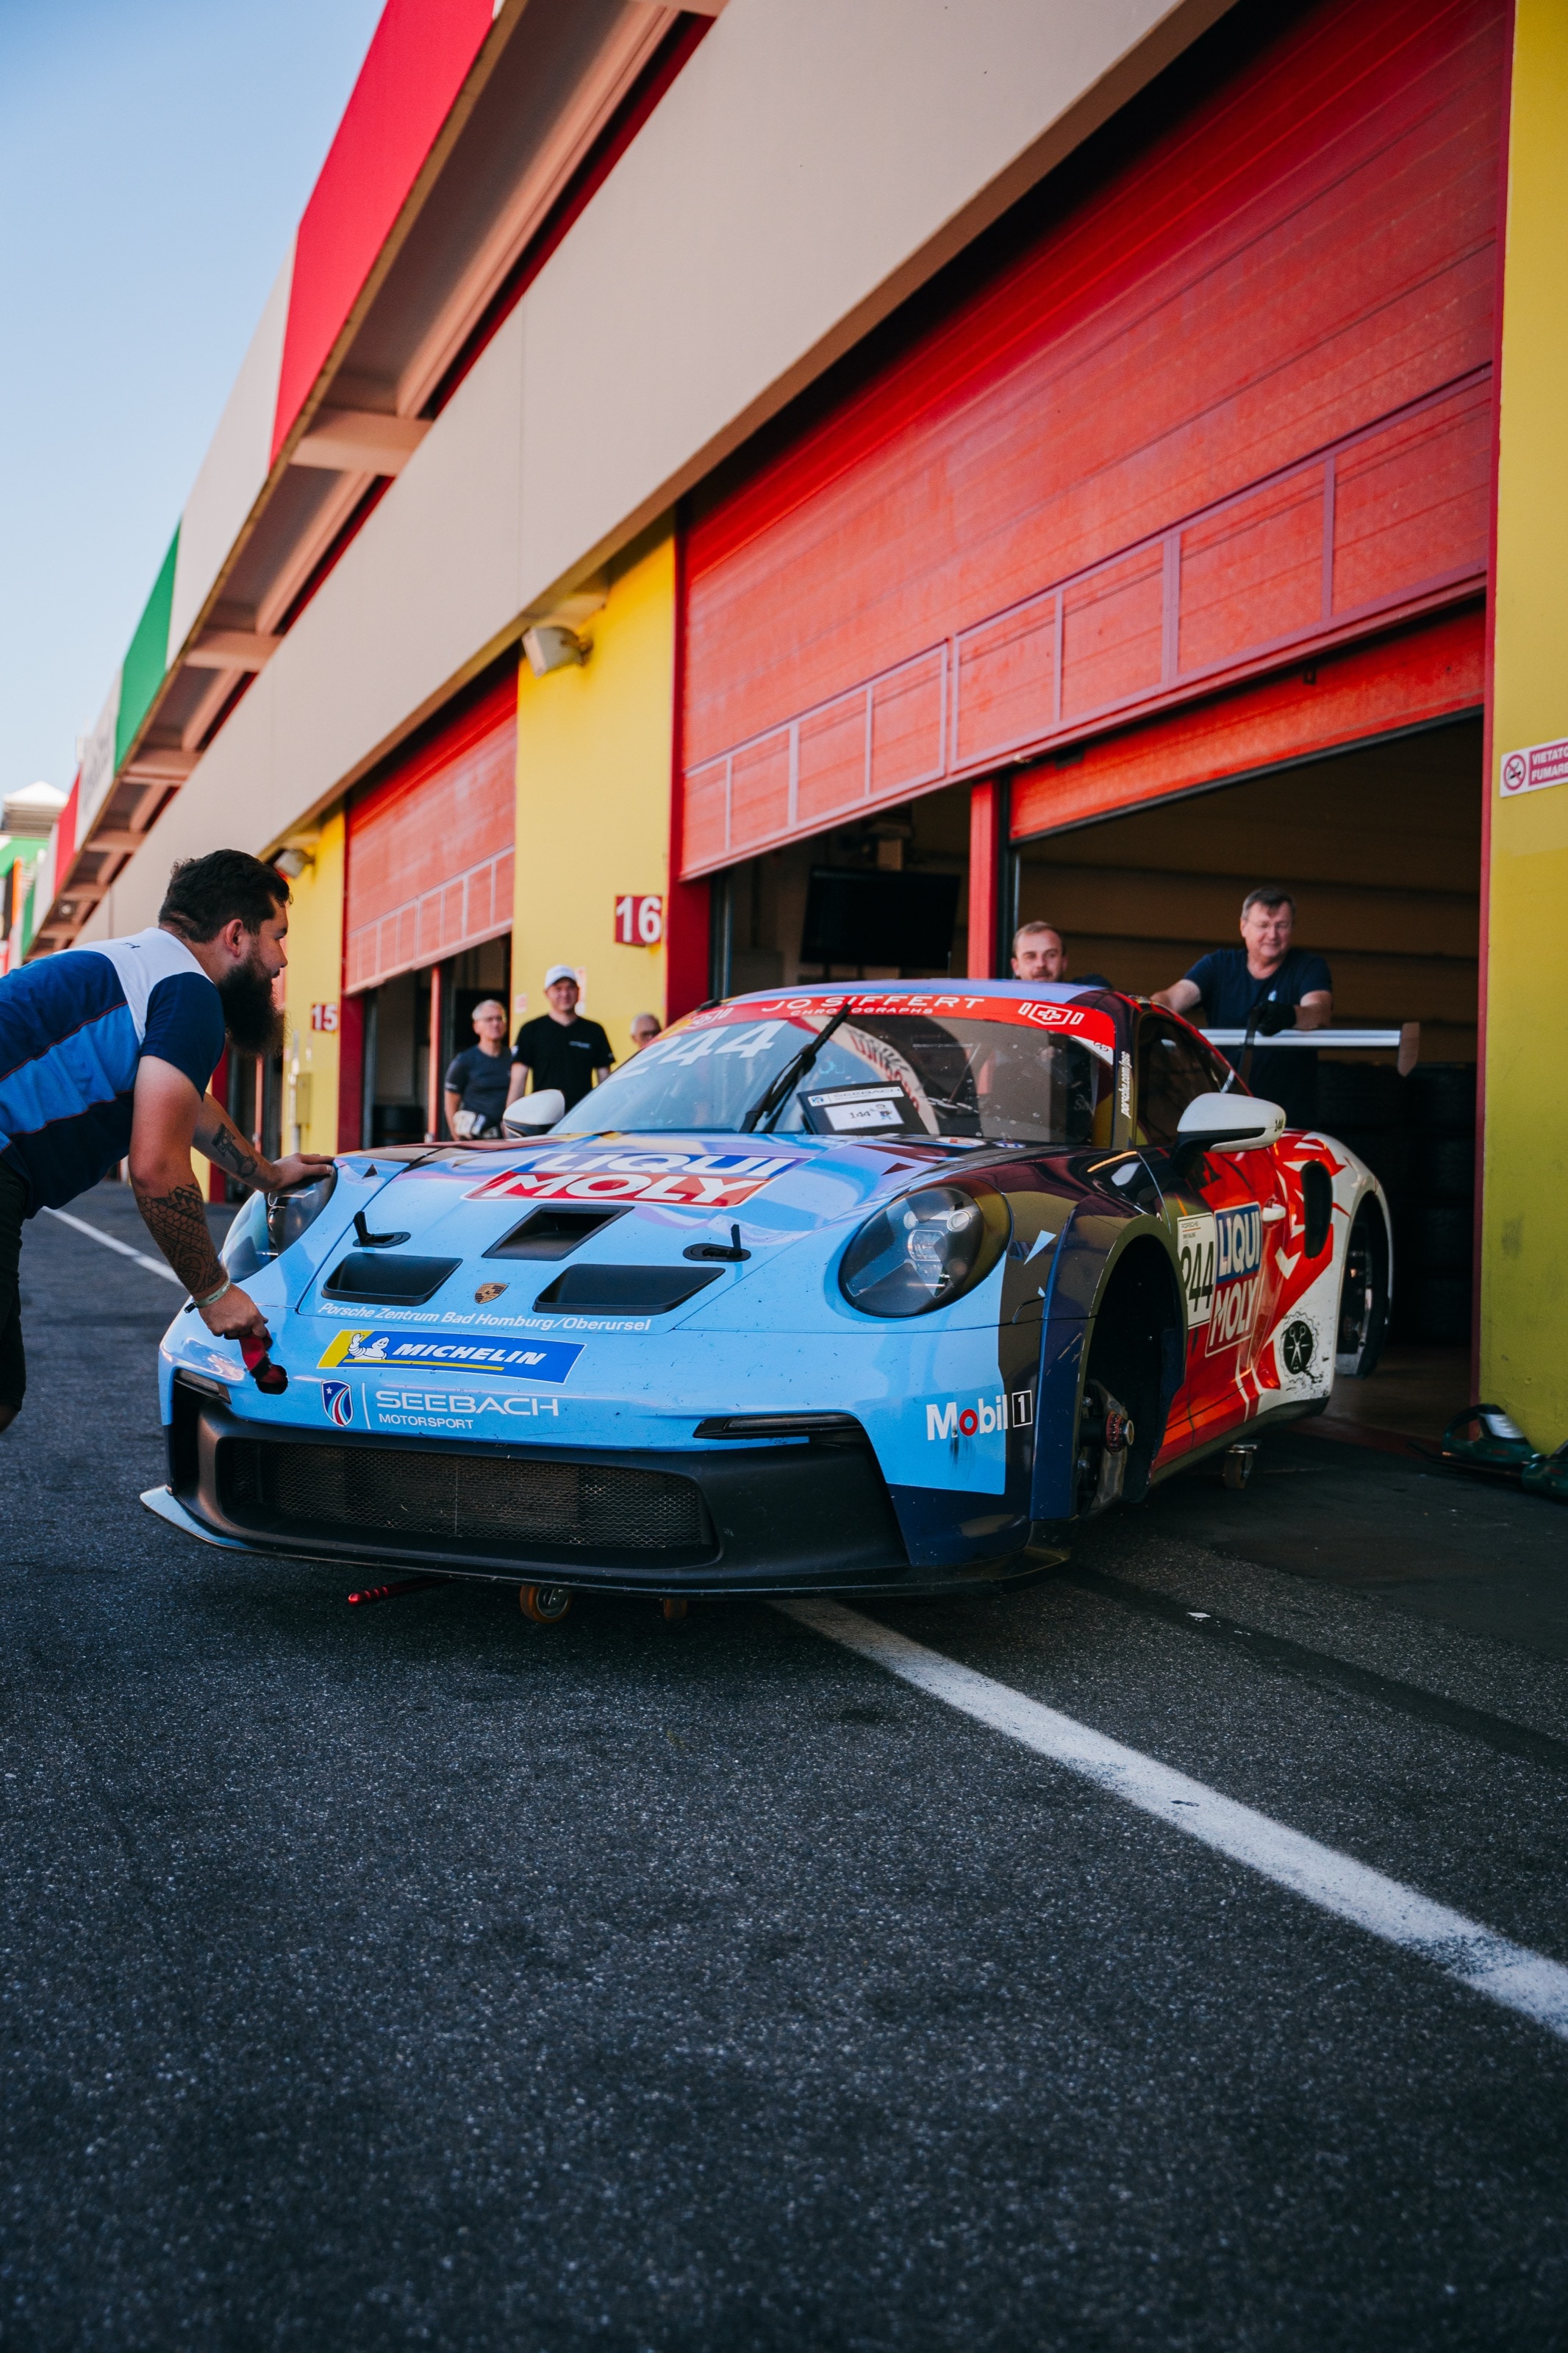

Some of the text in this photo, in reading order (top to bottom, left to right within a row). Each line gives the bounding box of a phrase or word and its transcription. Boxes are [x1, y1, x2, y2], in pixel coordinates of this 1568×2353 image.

[616, 896, 661, 943] 16
[312, 1004, 337, 1031] 15
[761, 996, 984, 1012] JO SIFFERT
[790, 1007, 934, 1016] CHROOGRAPHS
[603, 1020, 788, 1085] 244
[849, 1110, 871, 1119] 144
[528, 1152, 797, 1176] LIQUI
[482, 1174, 766, 1203] MOLY
[1218, 1210, 1259, 1277] LIQUI
[1181, 1241, 1214, 1312] 244
[318, 1302, 651, 1332] Porsche Zentrum Bad Homburg/Oberursel
[1209, 1277, 1259, 1346] MOLY
[393, 1343, 547, 1365] MICHELIN
[376, 1390, 559, 1416] SEEBACH
[379, 1413, 473, 1429] MOTORSPORT
[926, 1394, 1025, 1441] Mobil 1
